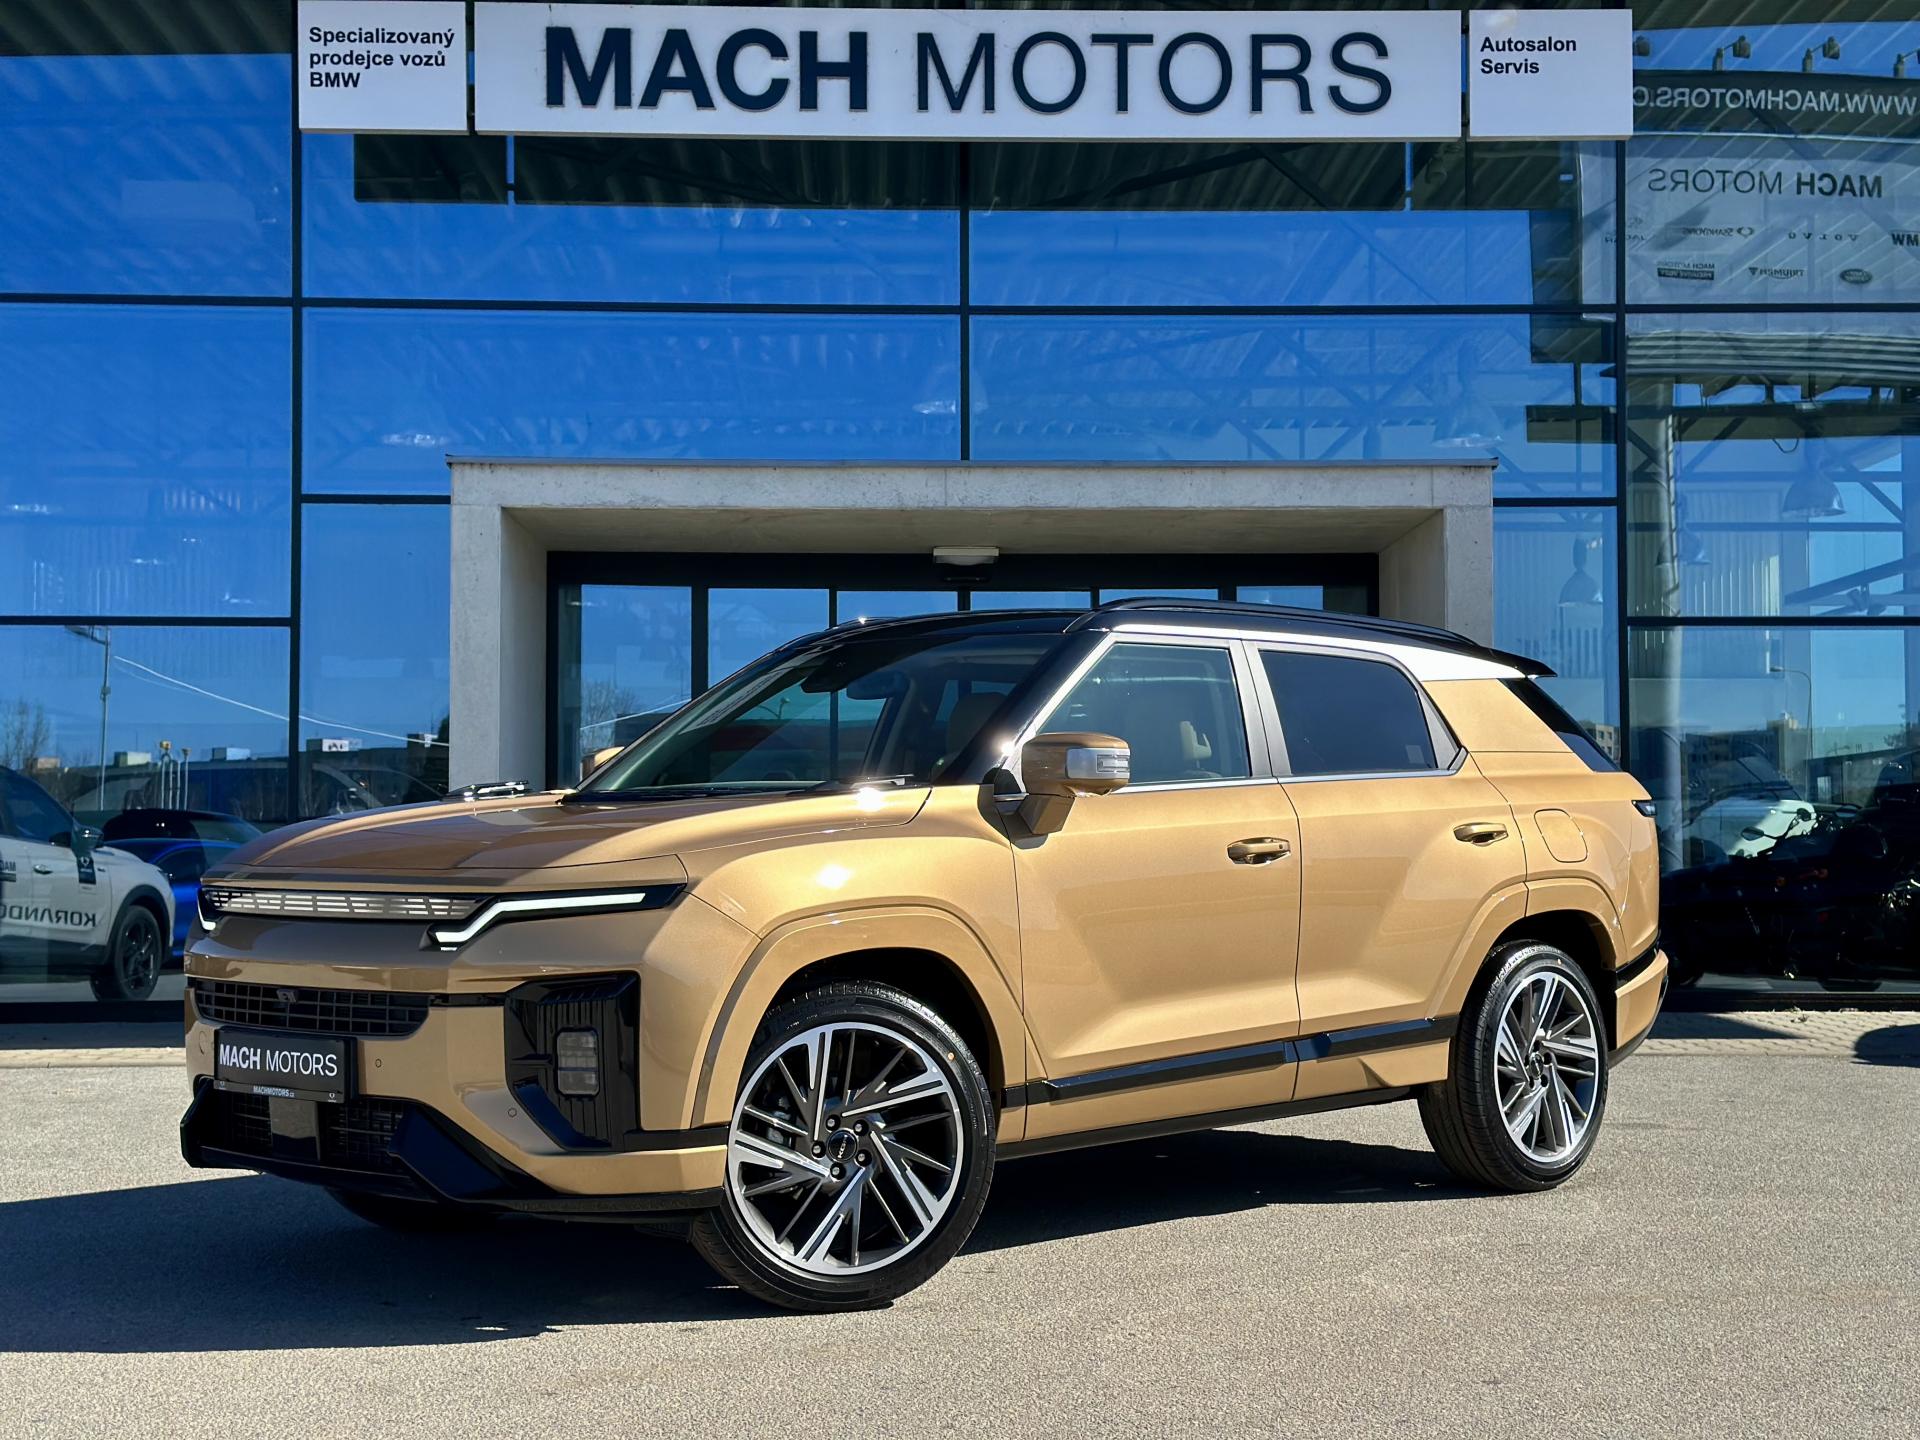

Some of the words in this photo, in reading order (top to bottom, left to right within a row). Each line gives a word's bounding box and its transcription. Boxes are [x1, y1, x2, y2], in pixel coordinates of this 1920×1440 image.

[309, 26, 455, 48] Specializovaný
[1480, 36, 1577, 52] Autosalon
[309, 50, 394, 69] prodejce
[400, 50, 446, 67] vozů
[1480, 58, 1540, 74] Servis
[545, 26, 868, 112] MACH
[916, 31, 1392, 114] MOTORS
[309, 72, 361, 88] BMW
[220, 1043, 261, 1070] MACH
[266, 1049, 338, 1077] MOTORS
